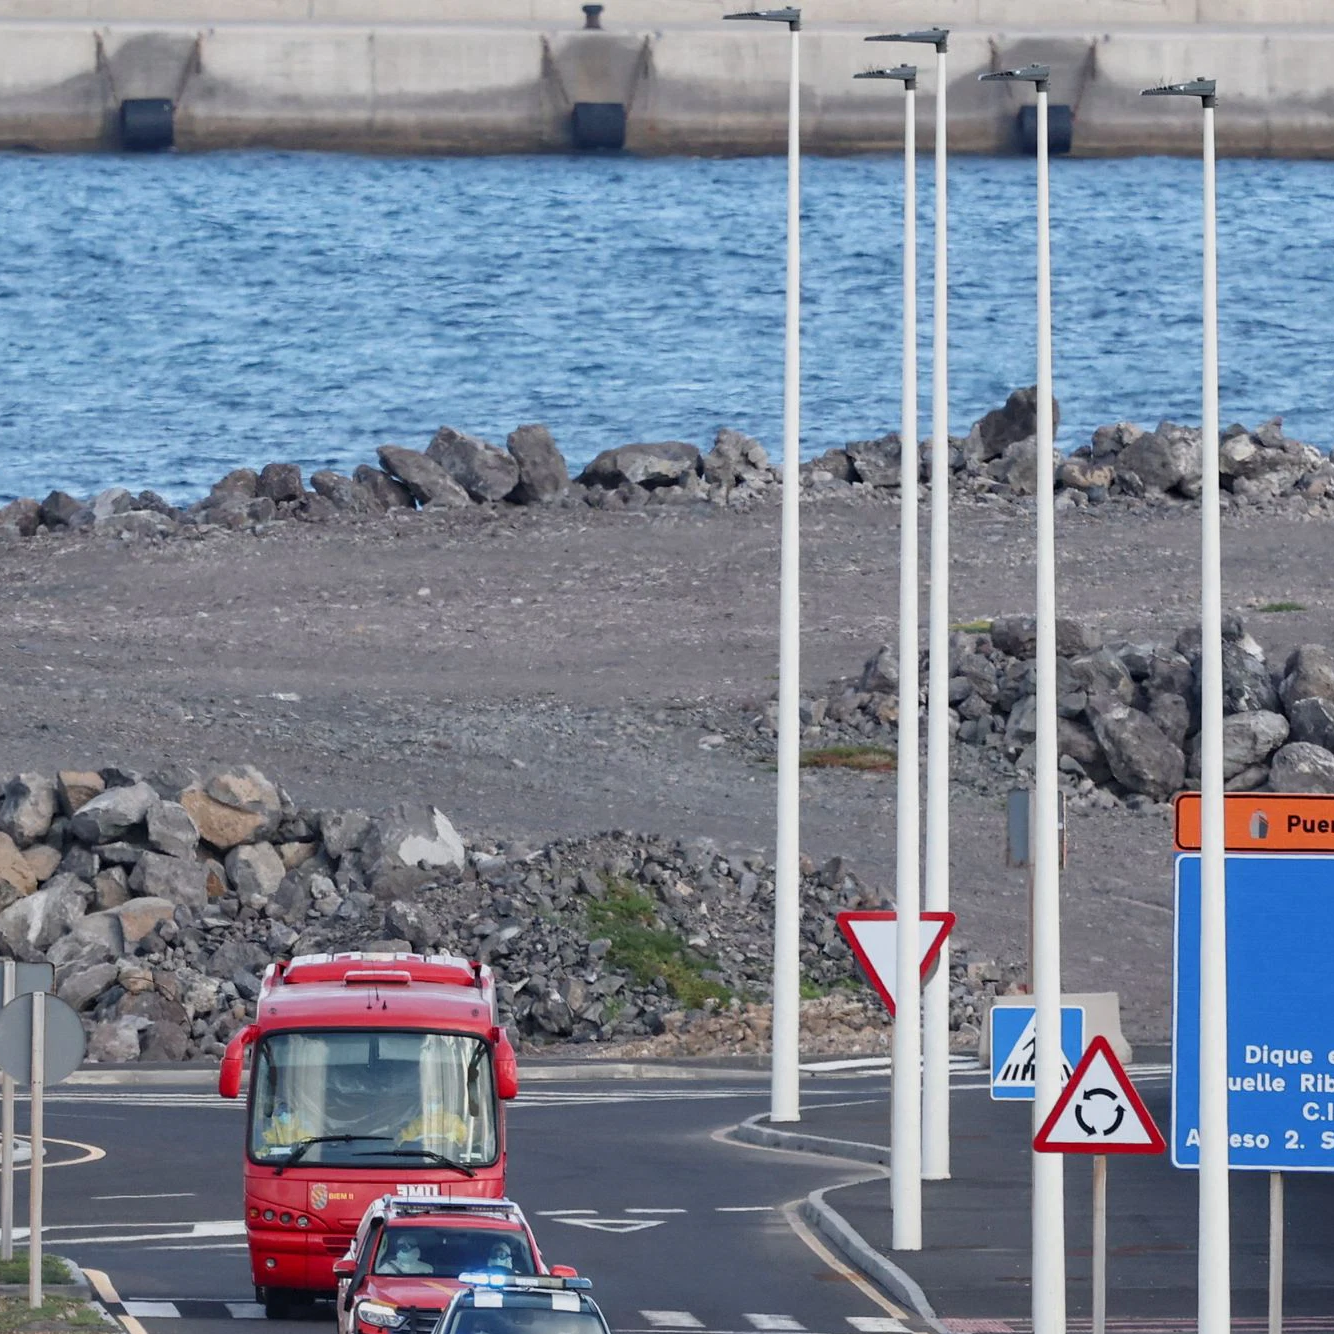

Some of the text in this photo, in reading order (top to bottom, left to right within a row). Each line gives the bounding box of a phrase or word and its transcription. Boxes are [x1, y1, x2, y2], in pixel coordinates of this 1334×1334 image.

[1245, 1045, 1313, 1067] Dique
[1227, 1072, 1285, 1092] uelle
[1185, 1128, 1270, 1149] Aeso
[1284, 1130, 1305, 1150] 2.
